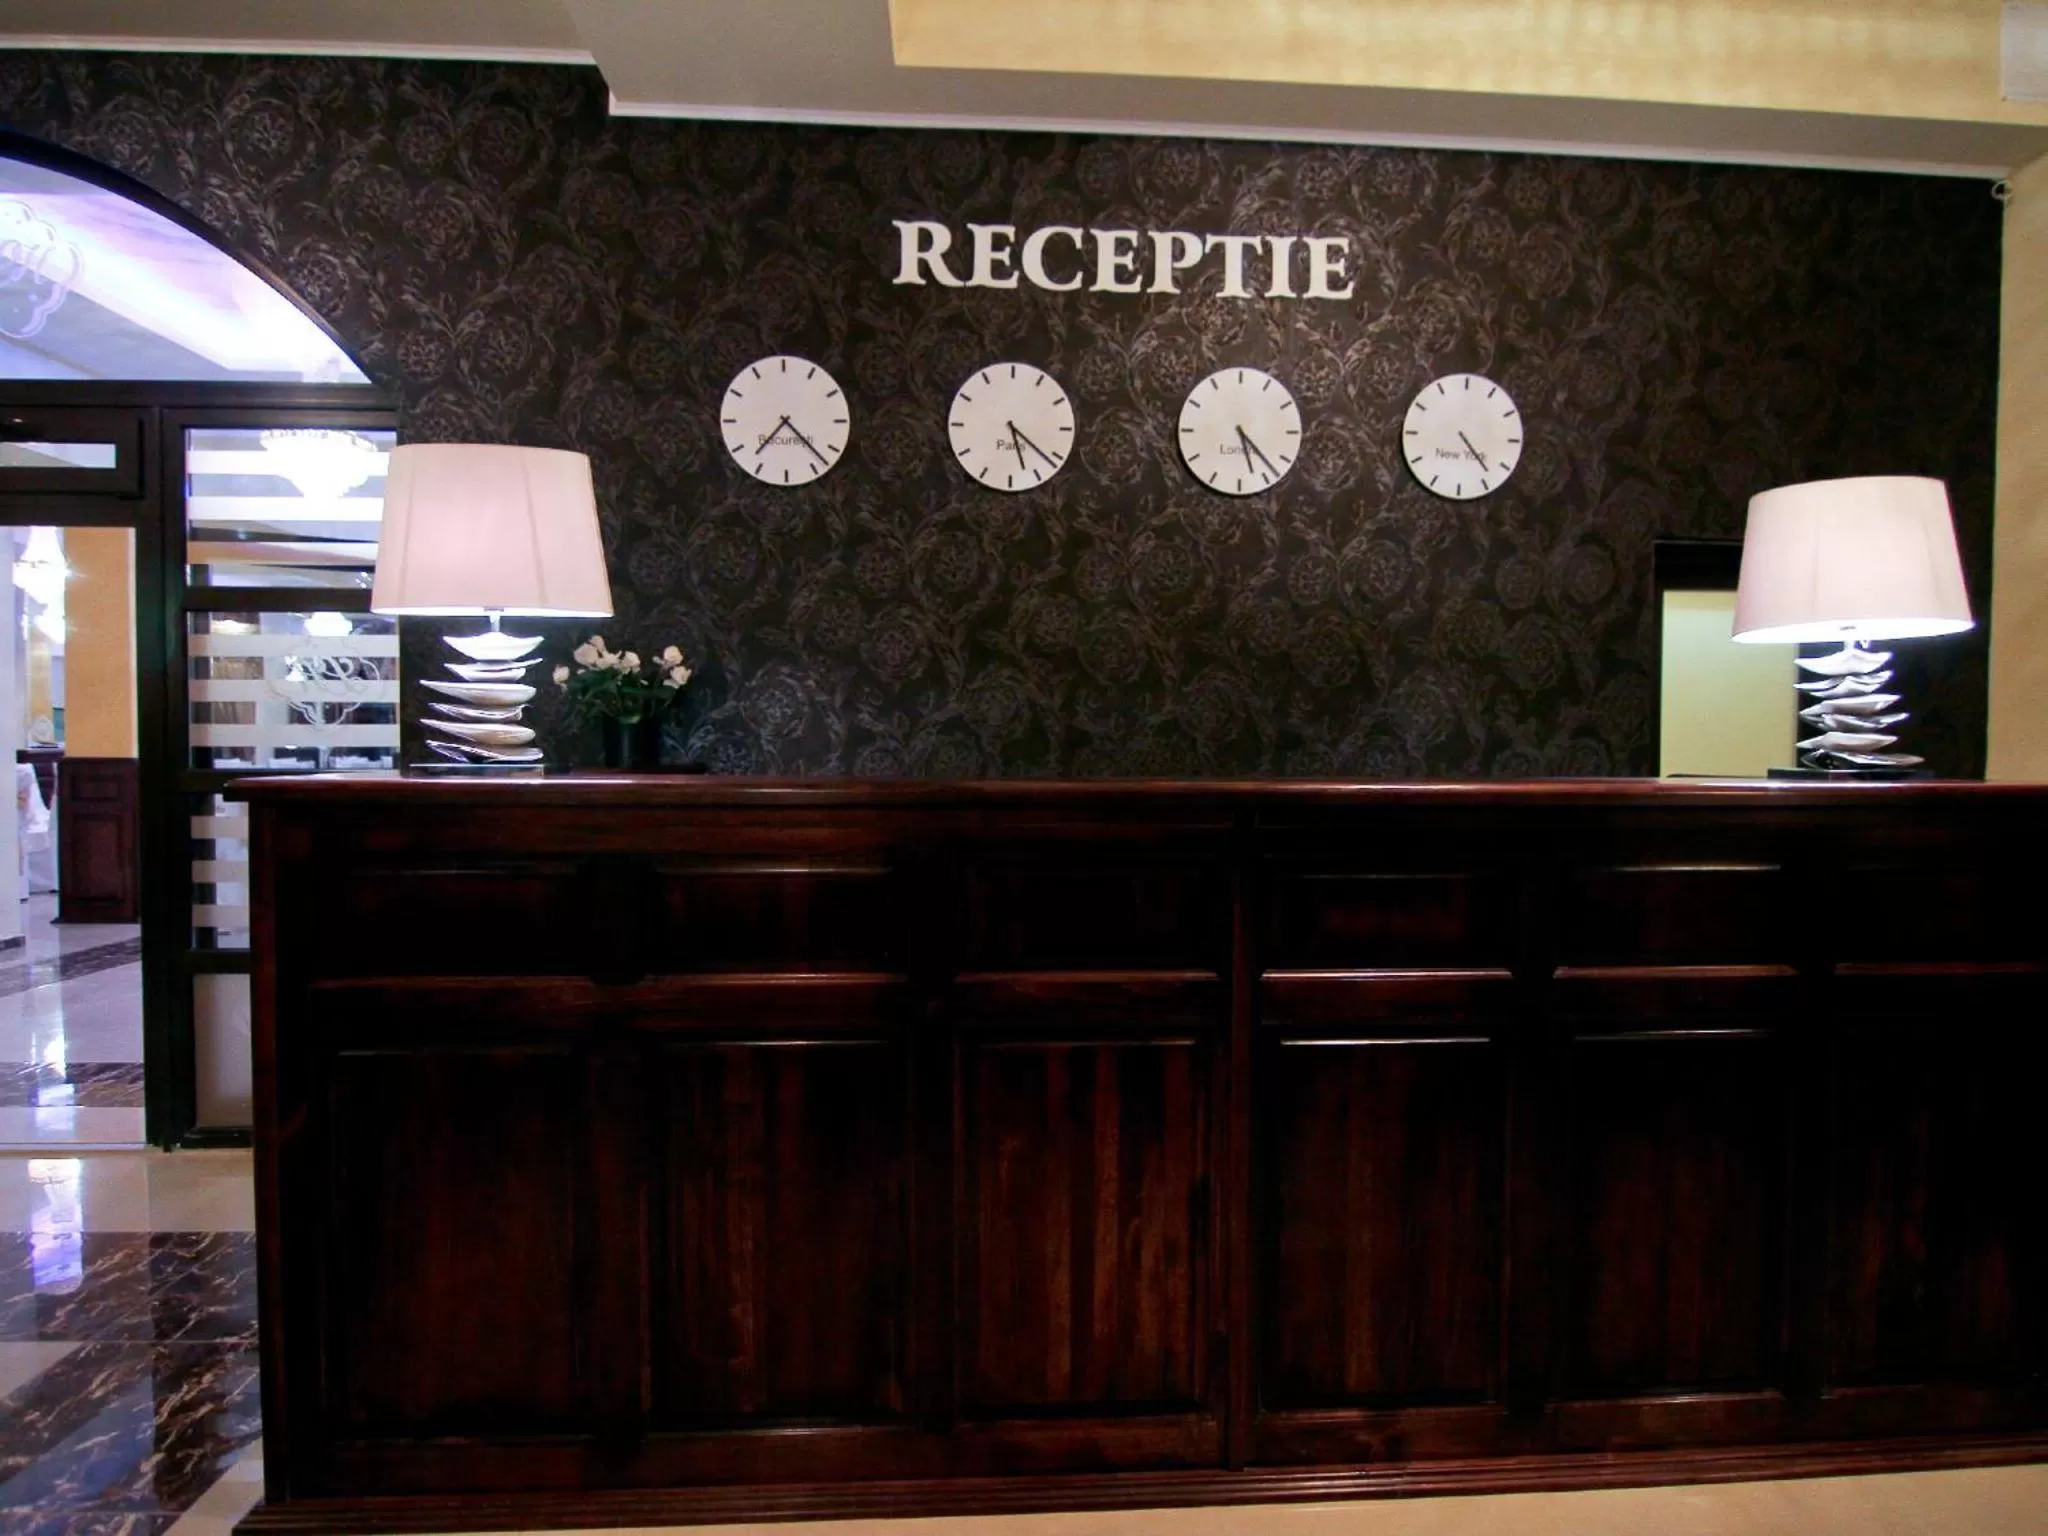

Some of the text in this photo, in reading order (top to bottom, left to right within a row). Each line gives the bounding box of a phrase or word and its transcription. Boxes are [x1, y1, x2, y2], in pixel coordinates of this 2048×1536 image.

[892, 220, 1354, 299] RECEPTIE
[996, 439, 1026, 452] Pars
[1436, 447, 1487, 461] New Yok
